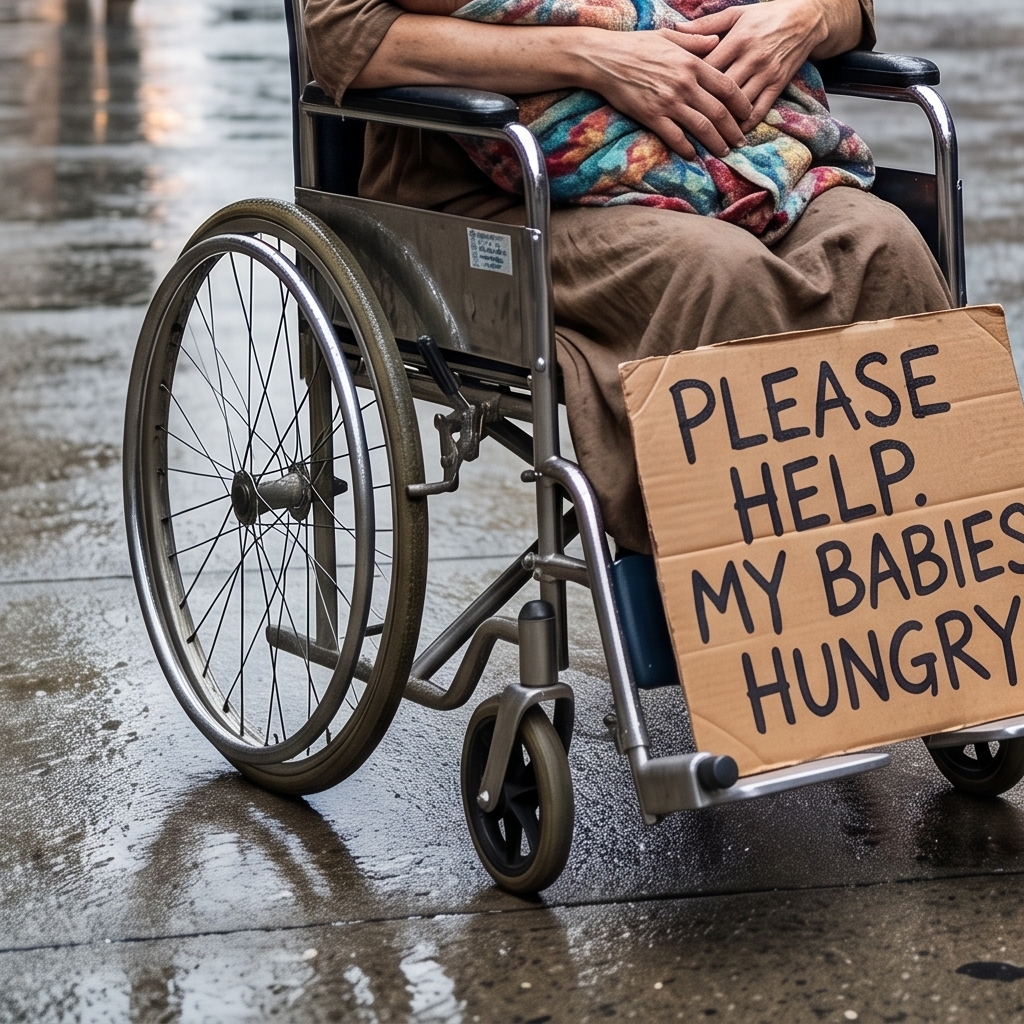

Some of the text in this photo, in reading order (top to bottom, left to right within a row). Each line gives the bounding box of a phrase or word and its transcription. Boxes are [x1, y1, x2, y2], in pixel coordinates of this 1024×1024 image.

[669, 344, 951, 464] PLEASE
[730, 439, 928, 544] HELP.
[691, 550, 787, 644] MY
